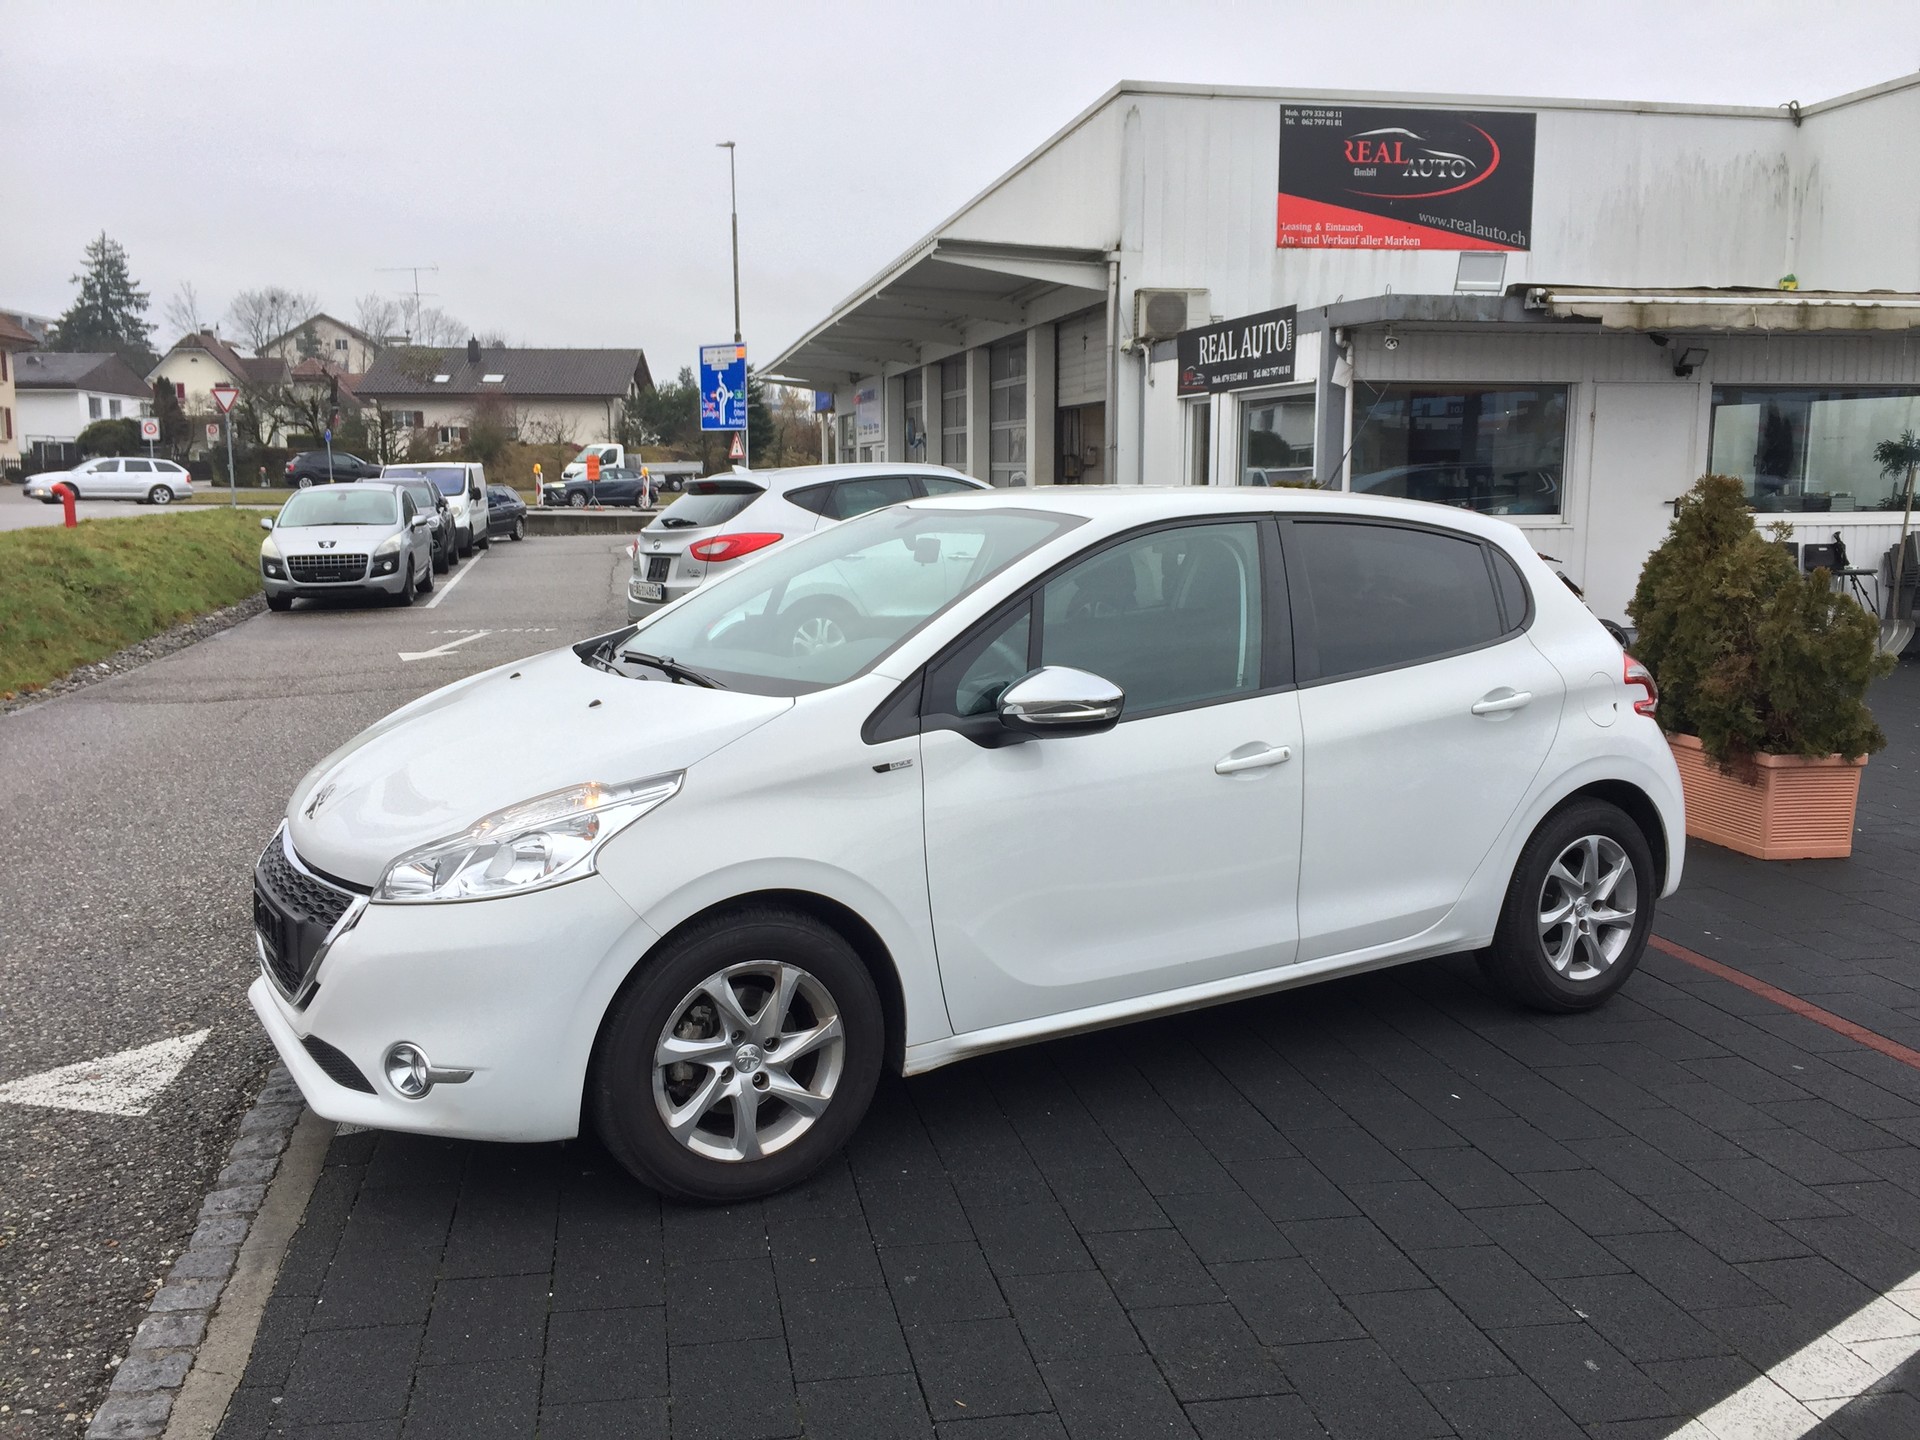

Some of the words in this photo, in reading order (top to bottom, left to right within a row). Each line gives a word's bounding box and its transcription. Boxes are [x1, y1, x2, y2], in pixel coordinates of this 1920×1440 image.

[1285, 109, 1299, 117] Mob.
[1344, 139, 1410, 164] REAL
[1354, 167, 1377, 177] GmbH
[1403, 158, 1467, 178] AUTO
[1281, 222, 1312, 233] Leasing
[1315, 223, 1322, 231] &
[1325, 223, 1363, 232] Eintausch
[1418, 211, 1526, 246] www.realauto.ch
[1281, 234, 1298, 244] An-
[1301, 234, 1319, 244] und
[1322, 234, 1358, 246] Verkauf
[1361, 235, 1383, 246] aller
[1384, 236, 1421, 246] Marken
[1199, 330, 1237, 365] REAL
[1240, 319, 1288, 359] AUTO
